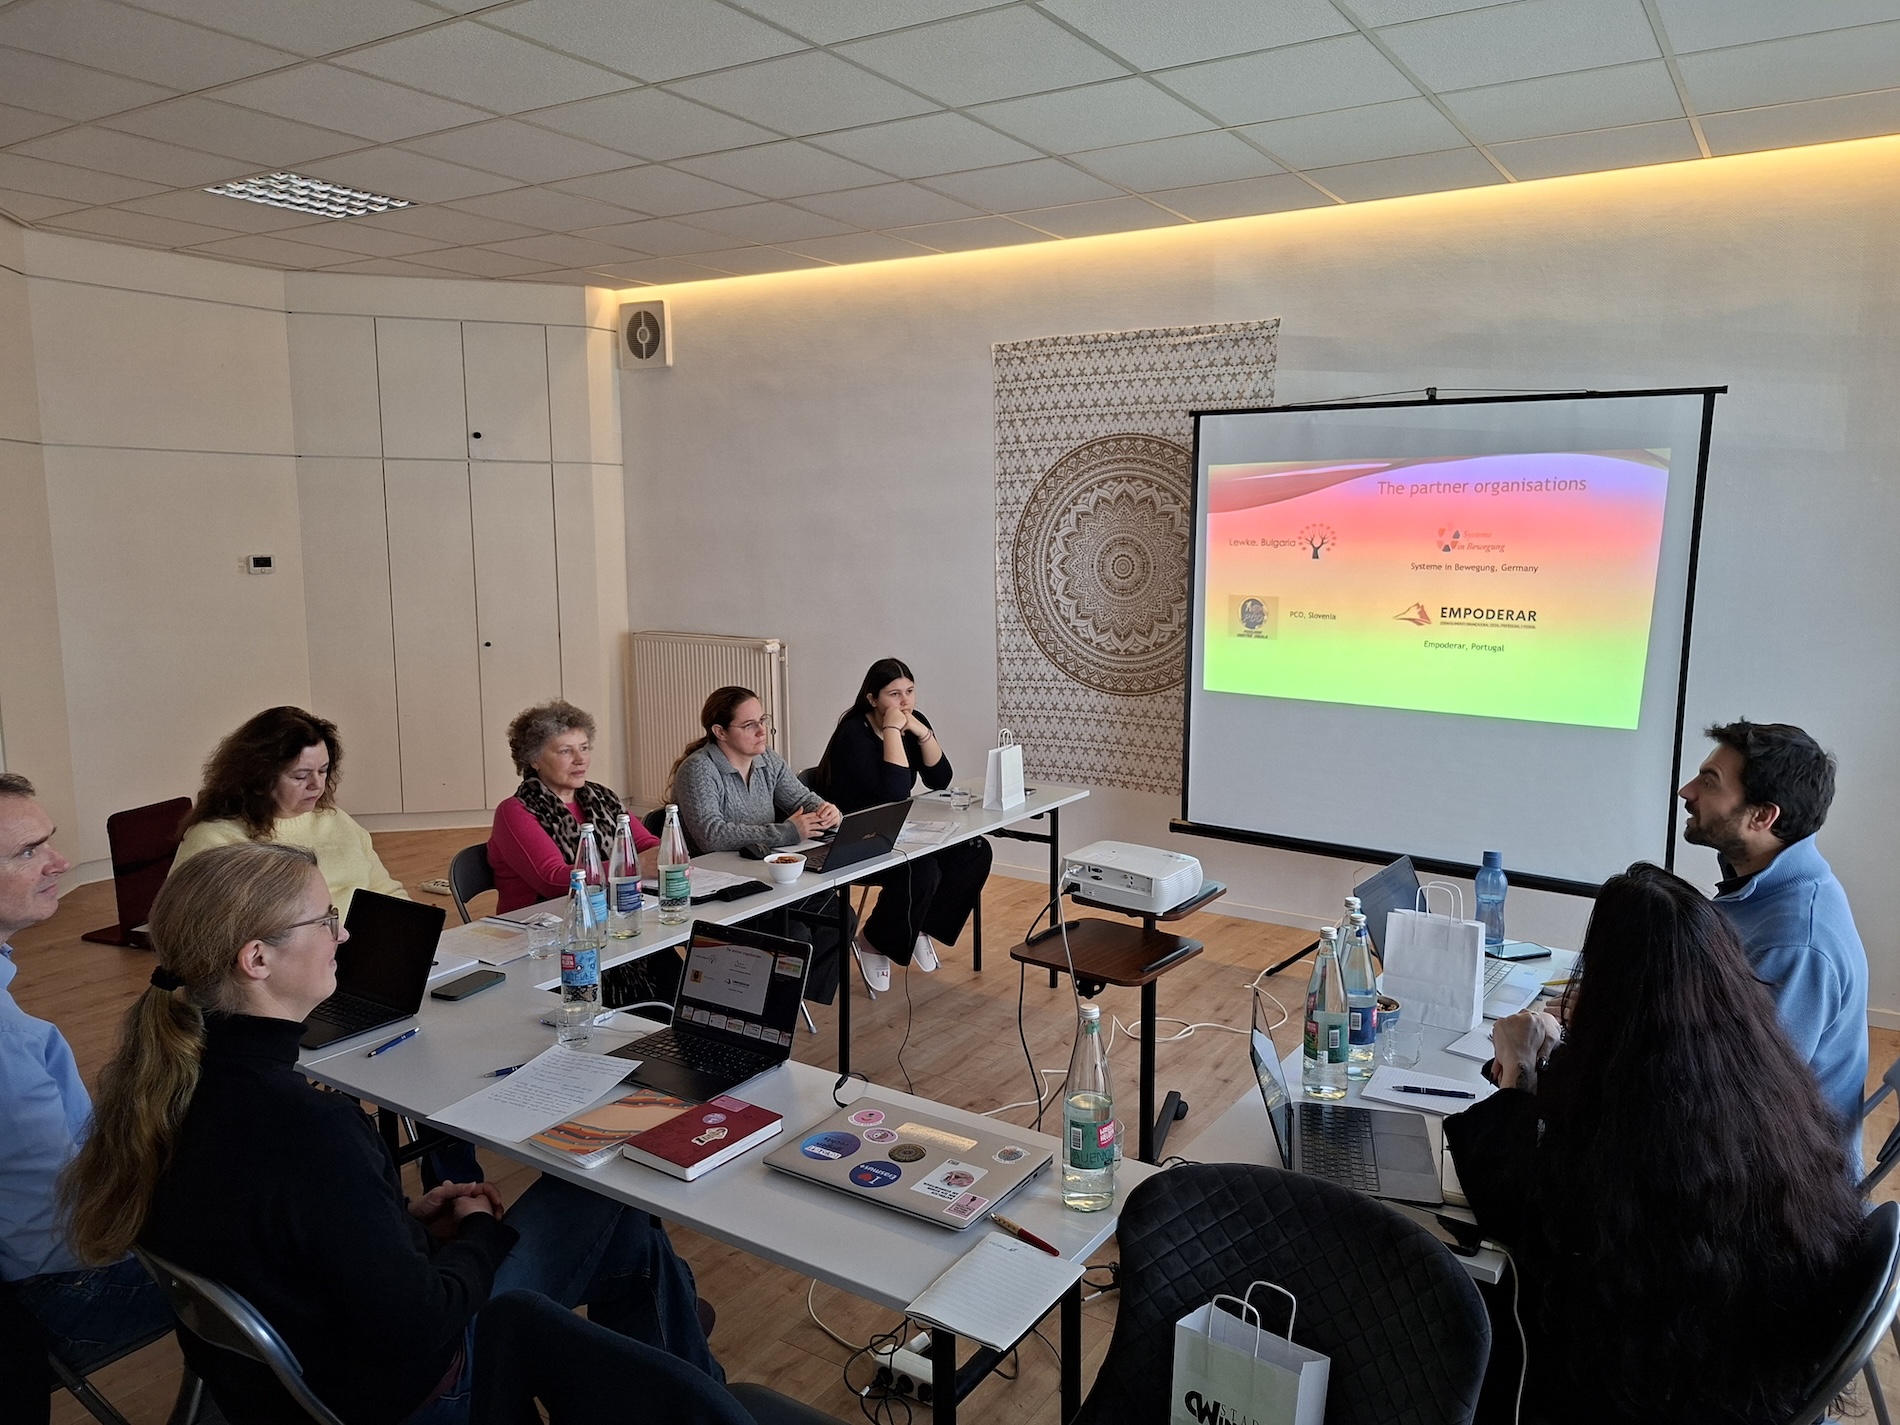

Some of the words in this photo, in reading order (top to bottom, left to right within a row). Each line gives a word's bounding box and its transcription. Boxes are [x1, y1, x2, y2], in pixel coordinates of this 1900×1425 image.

[1377, 480, 1405, 495] The
[1409, 480, 1469, 498] partner
[1474, 476, 1587, 496] organisations
[1261, 538, 1296, 549] Bulgaria
[1466, 542, 1506, 553] Bewegung
[1410, 562, 1442, 572] Systeme
[1445, 563, 1452, 571] in
[1454, 563, 1498, 573] Bewegung,
[1501, 563, 1539, 573] Germany
[1289, 611, 1306, 620] PCO,
[1308, 611, 1337, 620] Slovenia
[1440, 606, 1537, 622] EMPODERAR
[1423, 640, 1468, 651] Empoderar,
[1471, 643, 1505, 653] Portugal
[860, 1164, 898, 1181] Erasmus+
